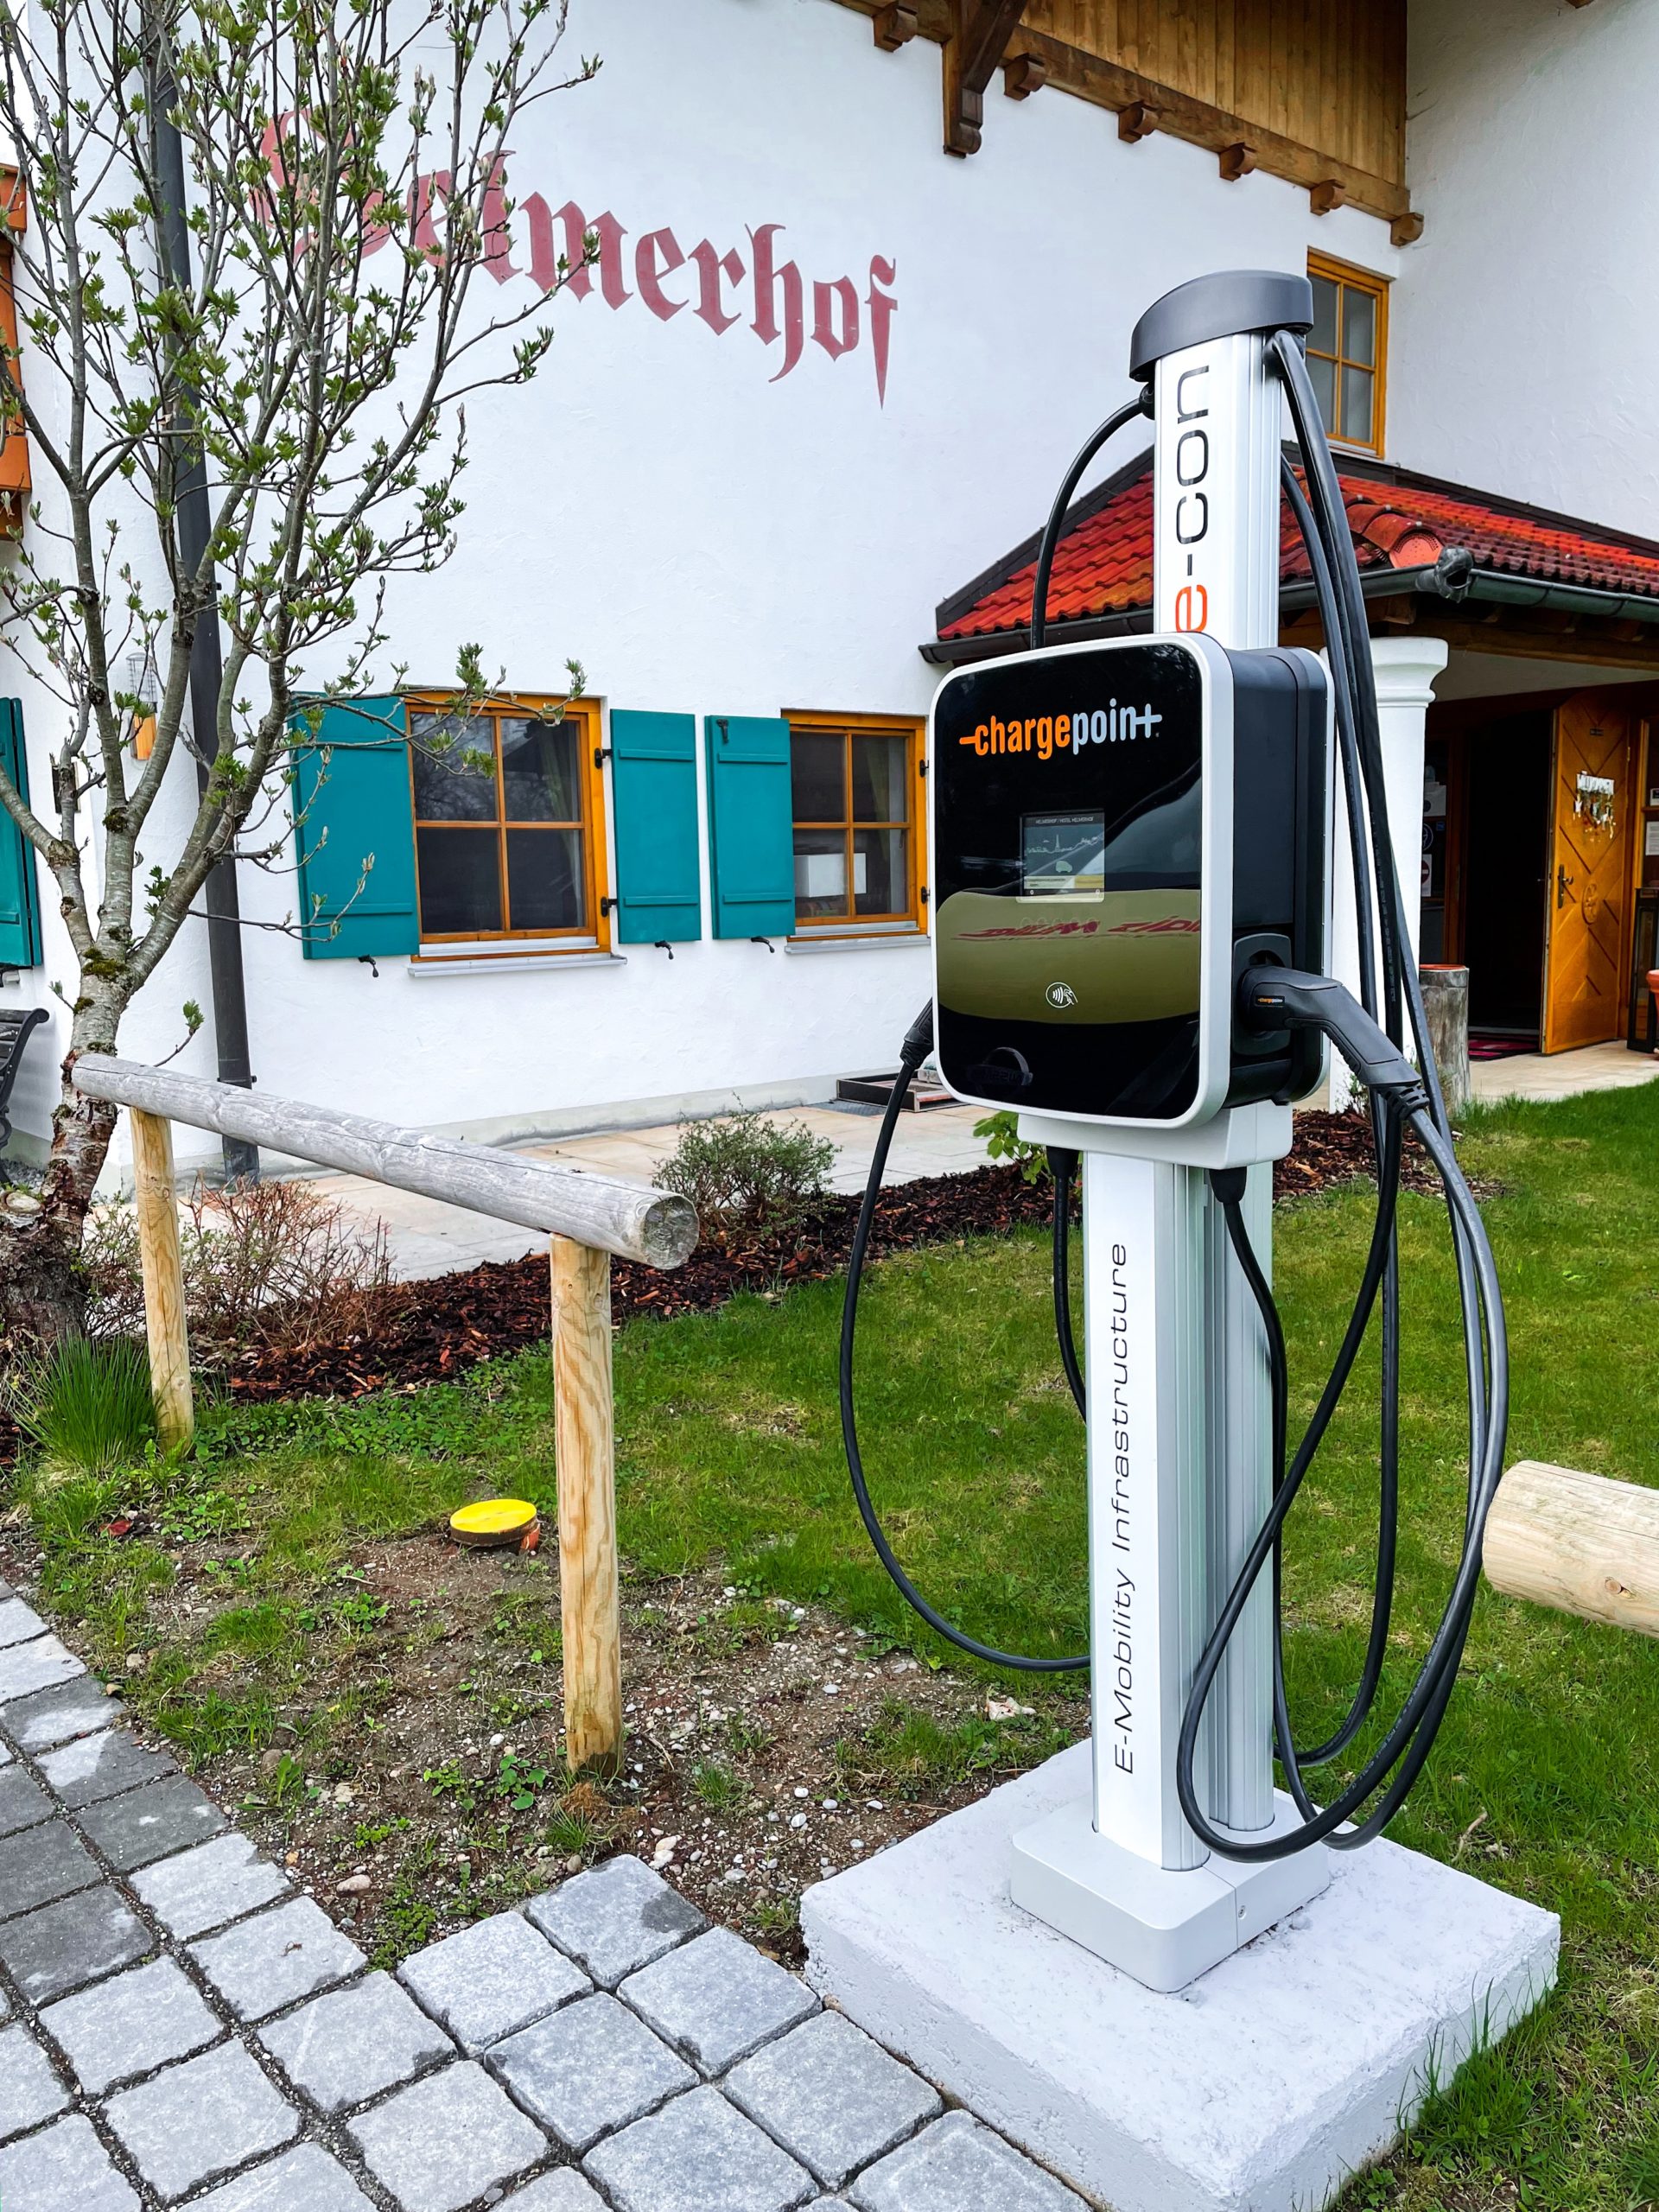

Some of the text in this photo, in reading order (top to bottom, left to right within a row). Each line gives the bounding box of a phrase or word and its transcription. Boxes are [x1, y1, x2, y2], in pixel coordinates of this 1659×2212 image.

[1175, 364, 1211, 633] e-con
[1110, 1243, 1136, 1776] E-Mobility Infrastructure
